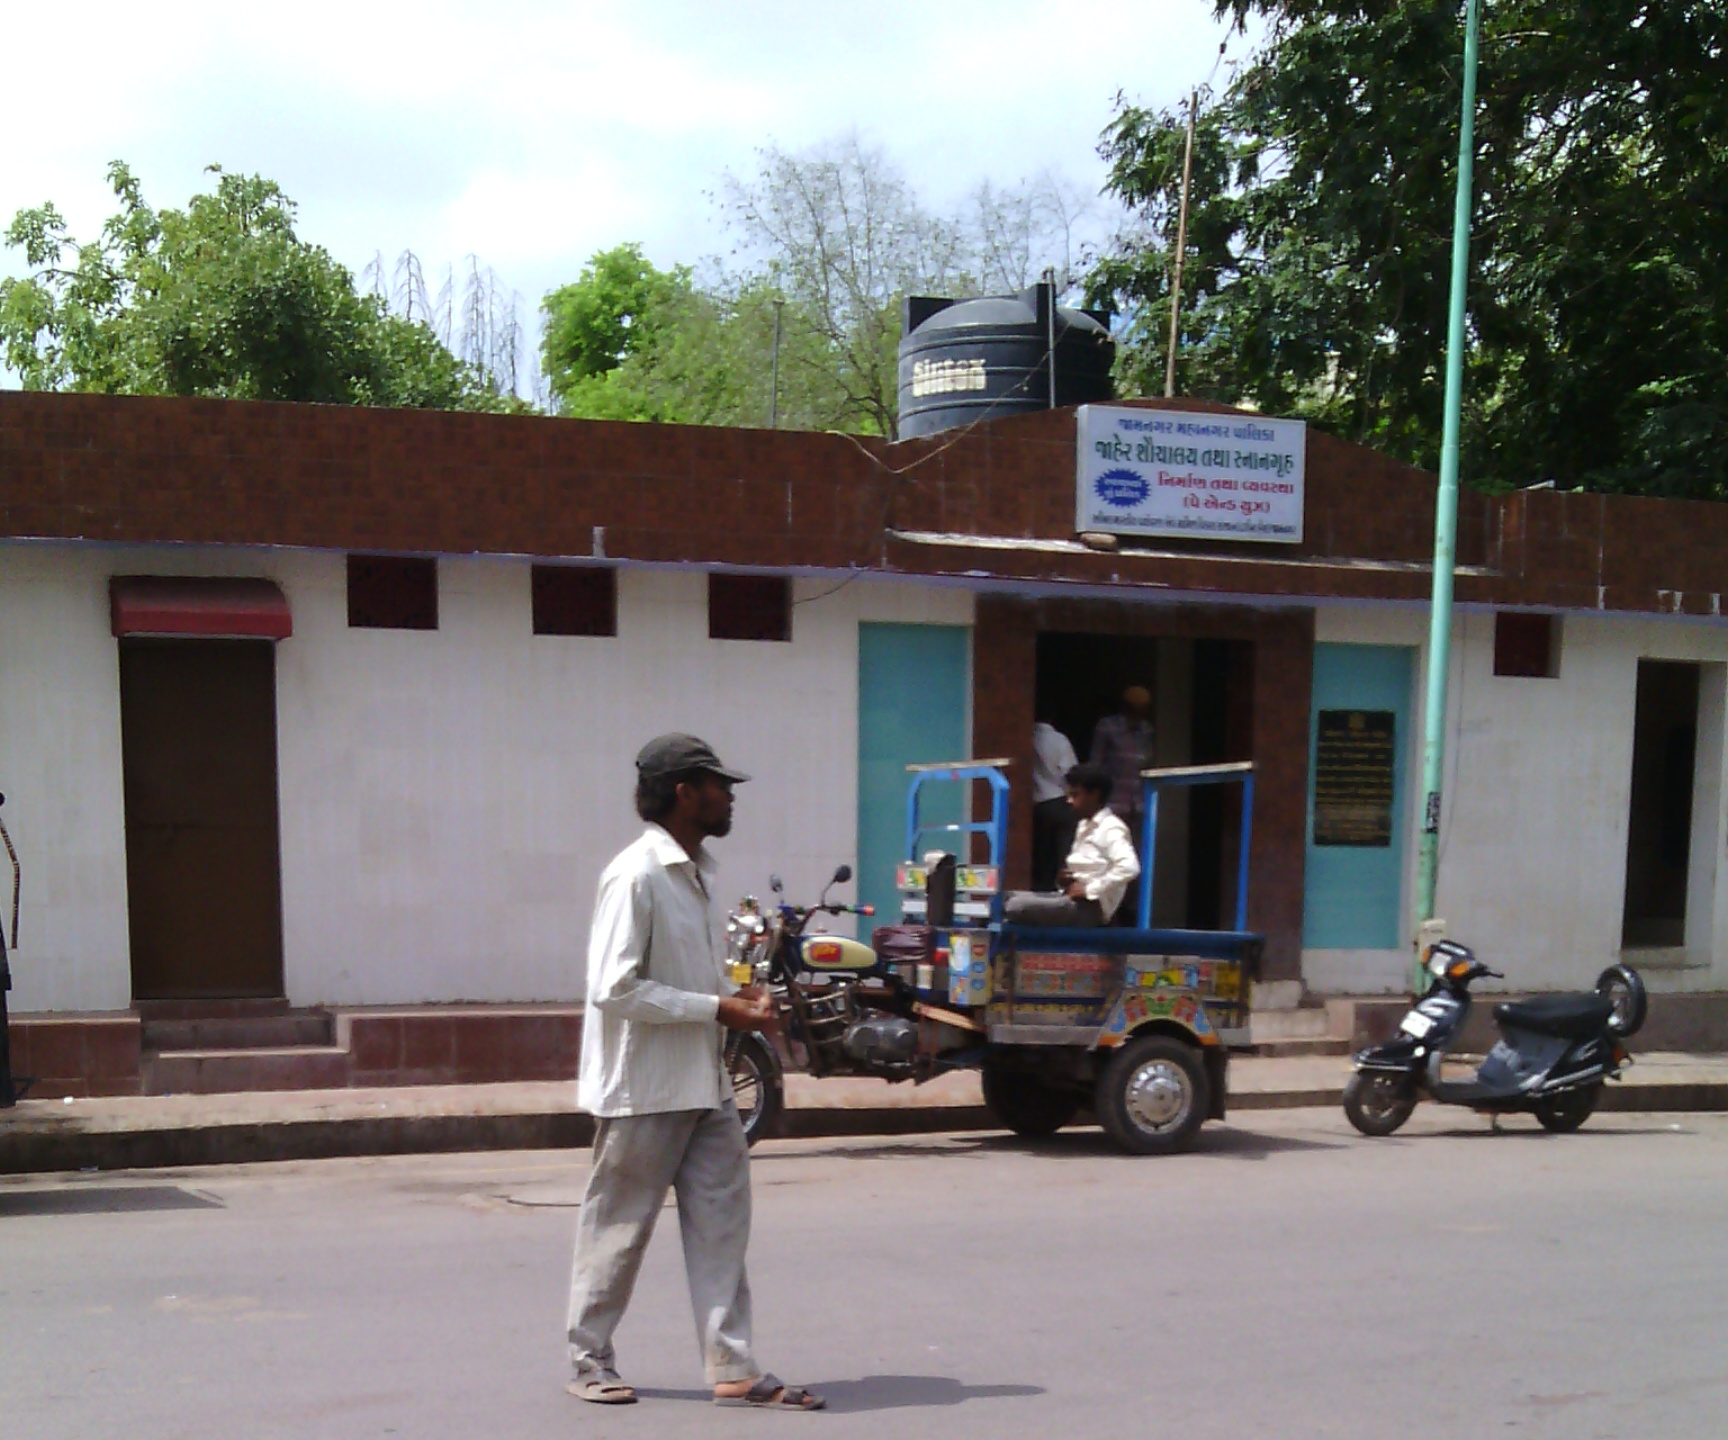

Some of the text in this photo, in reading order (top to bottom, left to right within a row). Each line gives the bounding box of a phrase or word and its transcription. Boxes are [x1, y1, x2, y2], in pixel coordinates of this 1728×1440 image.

[1118, 418, 1173, 434] જામનગર
[1233, 422, 1275, 442] પાલિકા
[1095, 433, 1294, 477] જાહેર શૌચાલય તથા સ્નાનગૃહ
[1157, 470, 1207, 489] નિર્માણ
[1210, 478, 1238, 491] તથા
[1242, 480, 1294, 495] વ્યવસ્થા
